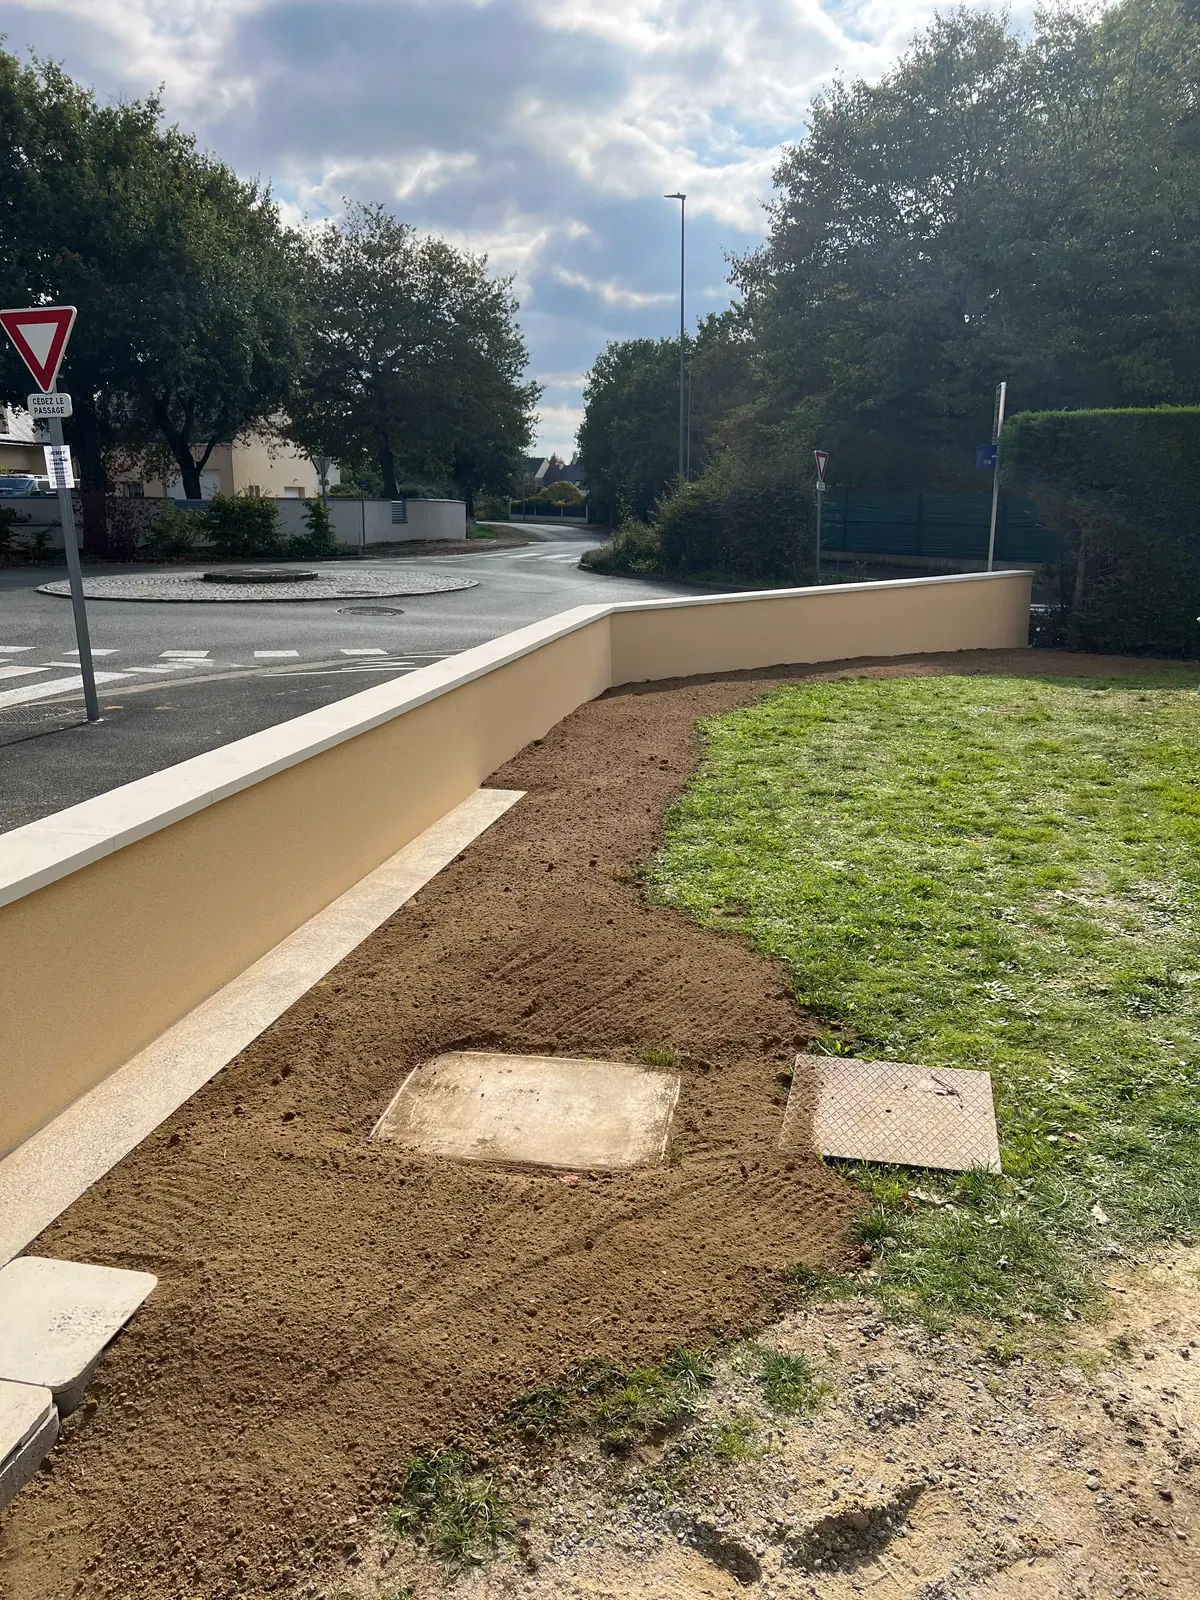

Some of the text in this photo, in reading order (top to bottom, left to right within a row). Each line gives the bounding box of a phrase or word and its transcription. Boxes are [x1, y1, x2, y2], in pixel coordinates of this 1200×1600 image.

[32, 396, 65, 405] CÉDEZ LE
[33, 406, 65, 414] PASSAGE
